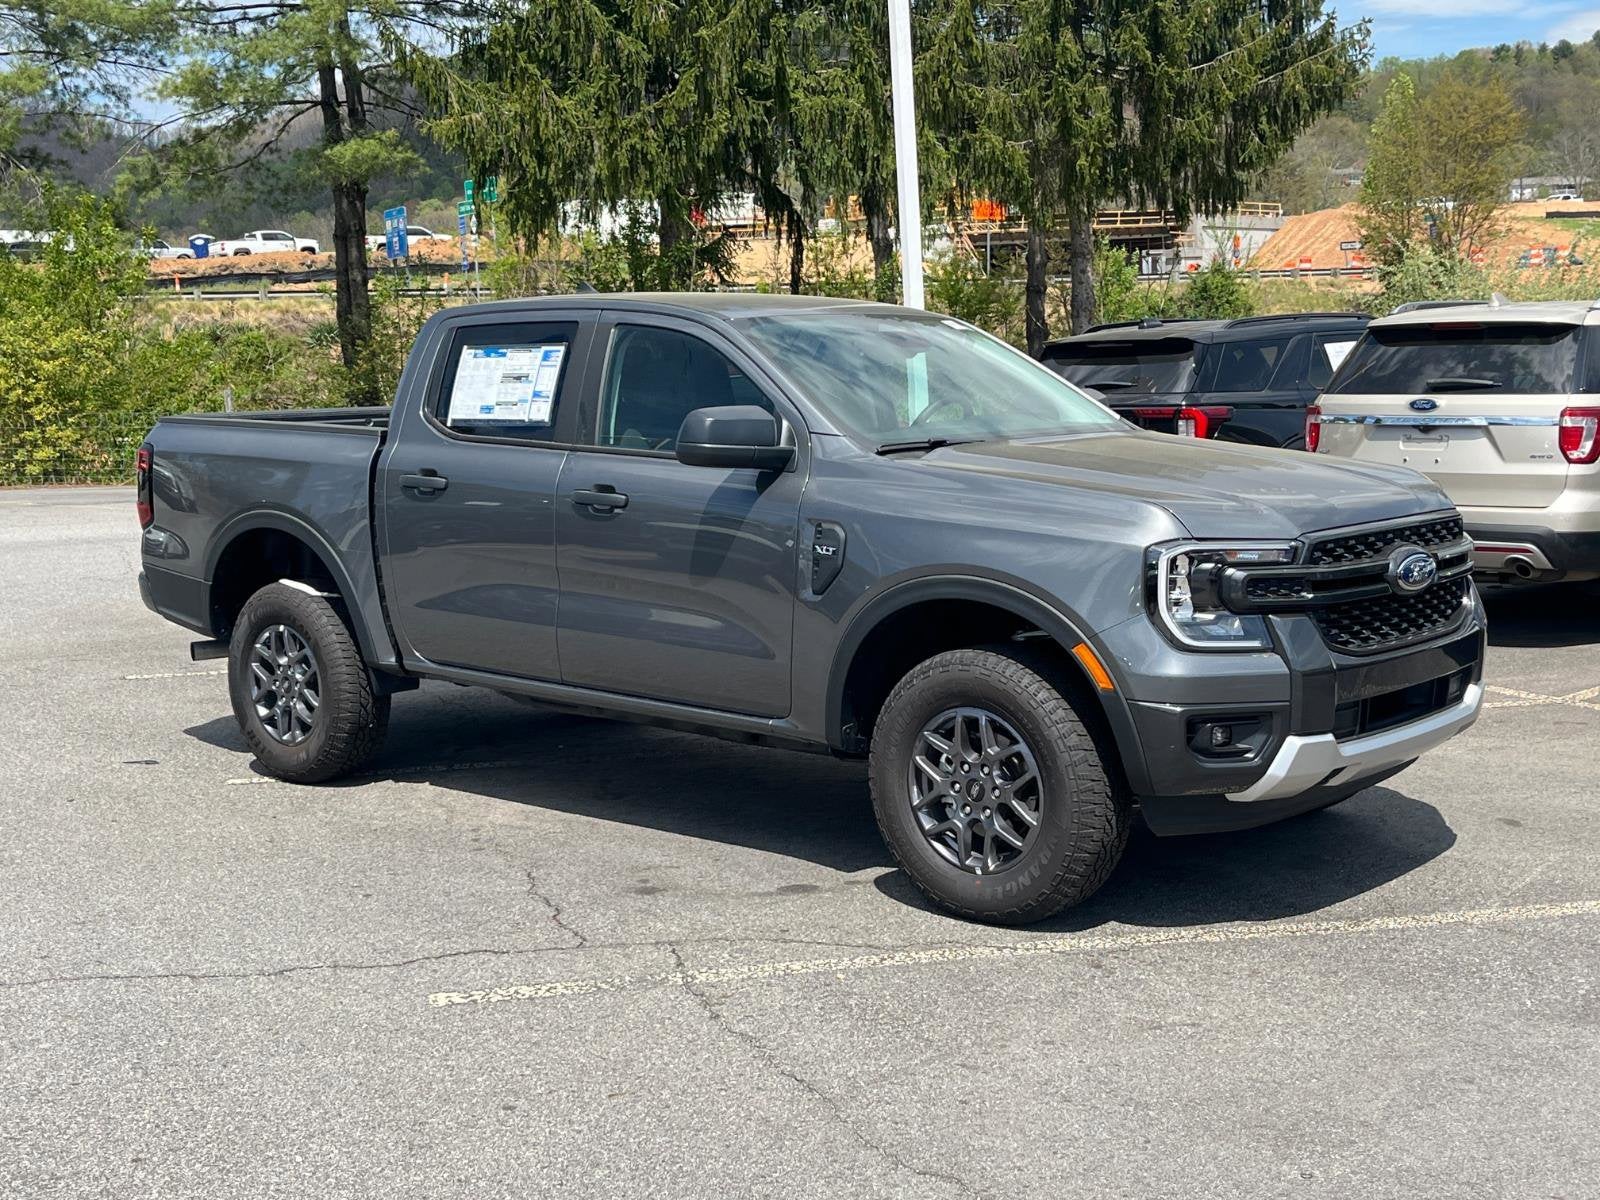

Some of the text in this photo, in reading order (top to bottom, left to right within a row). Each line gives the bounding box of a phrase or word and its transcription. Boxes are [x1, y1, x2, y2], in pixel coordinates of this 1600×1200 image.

[1412, 400, 1434, 409] Ford
[814, 545, 837, 555] XLT
[1406, 559, 1434, 583] Ford
